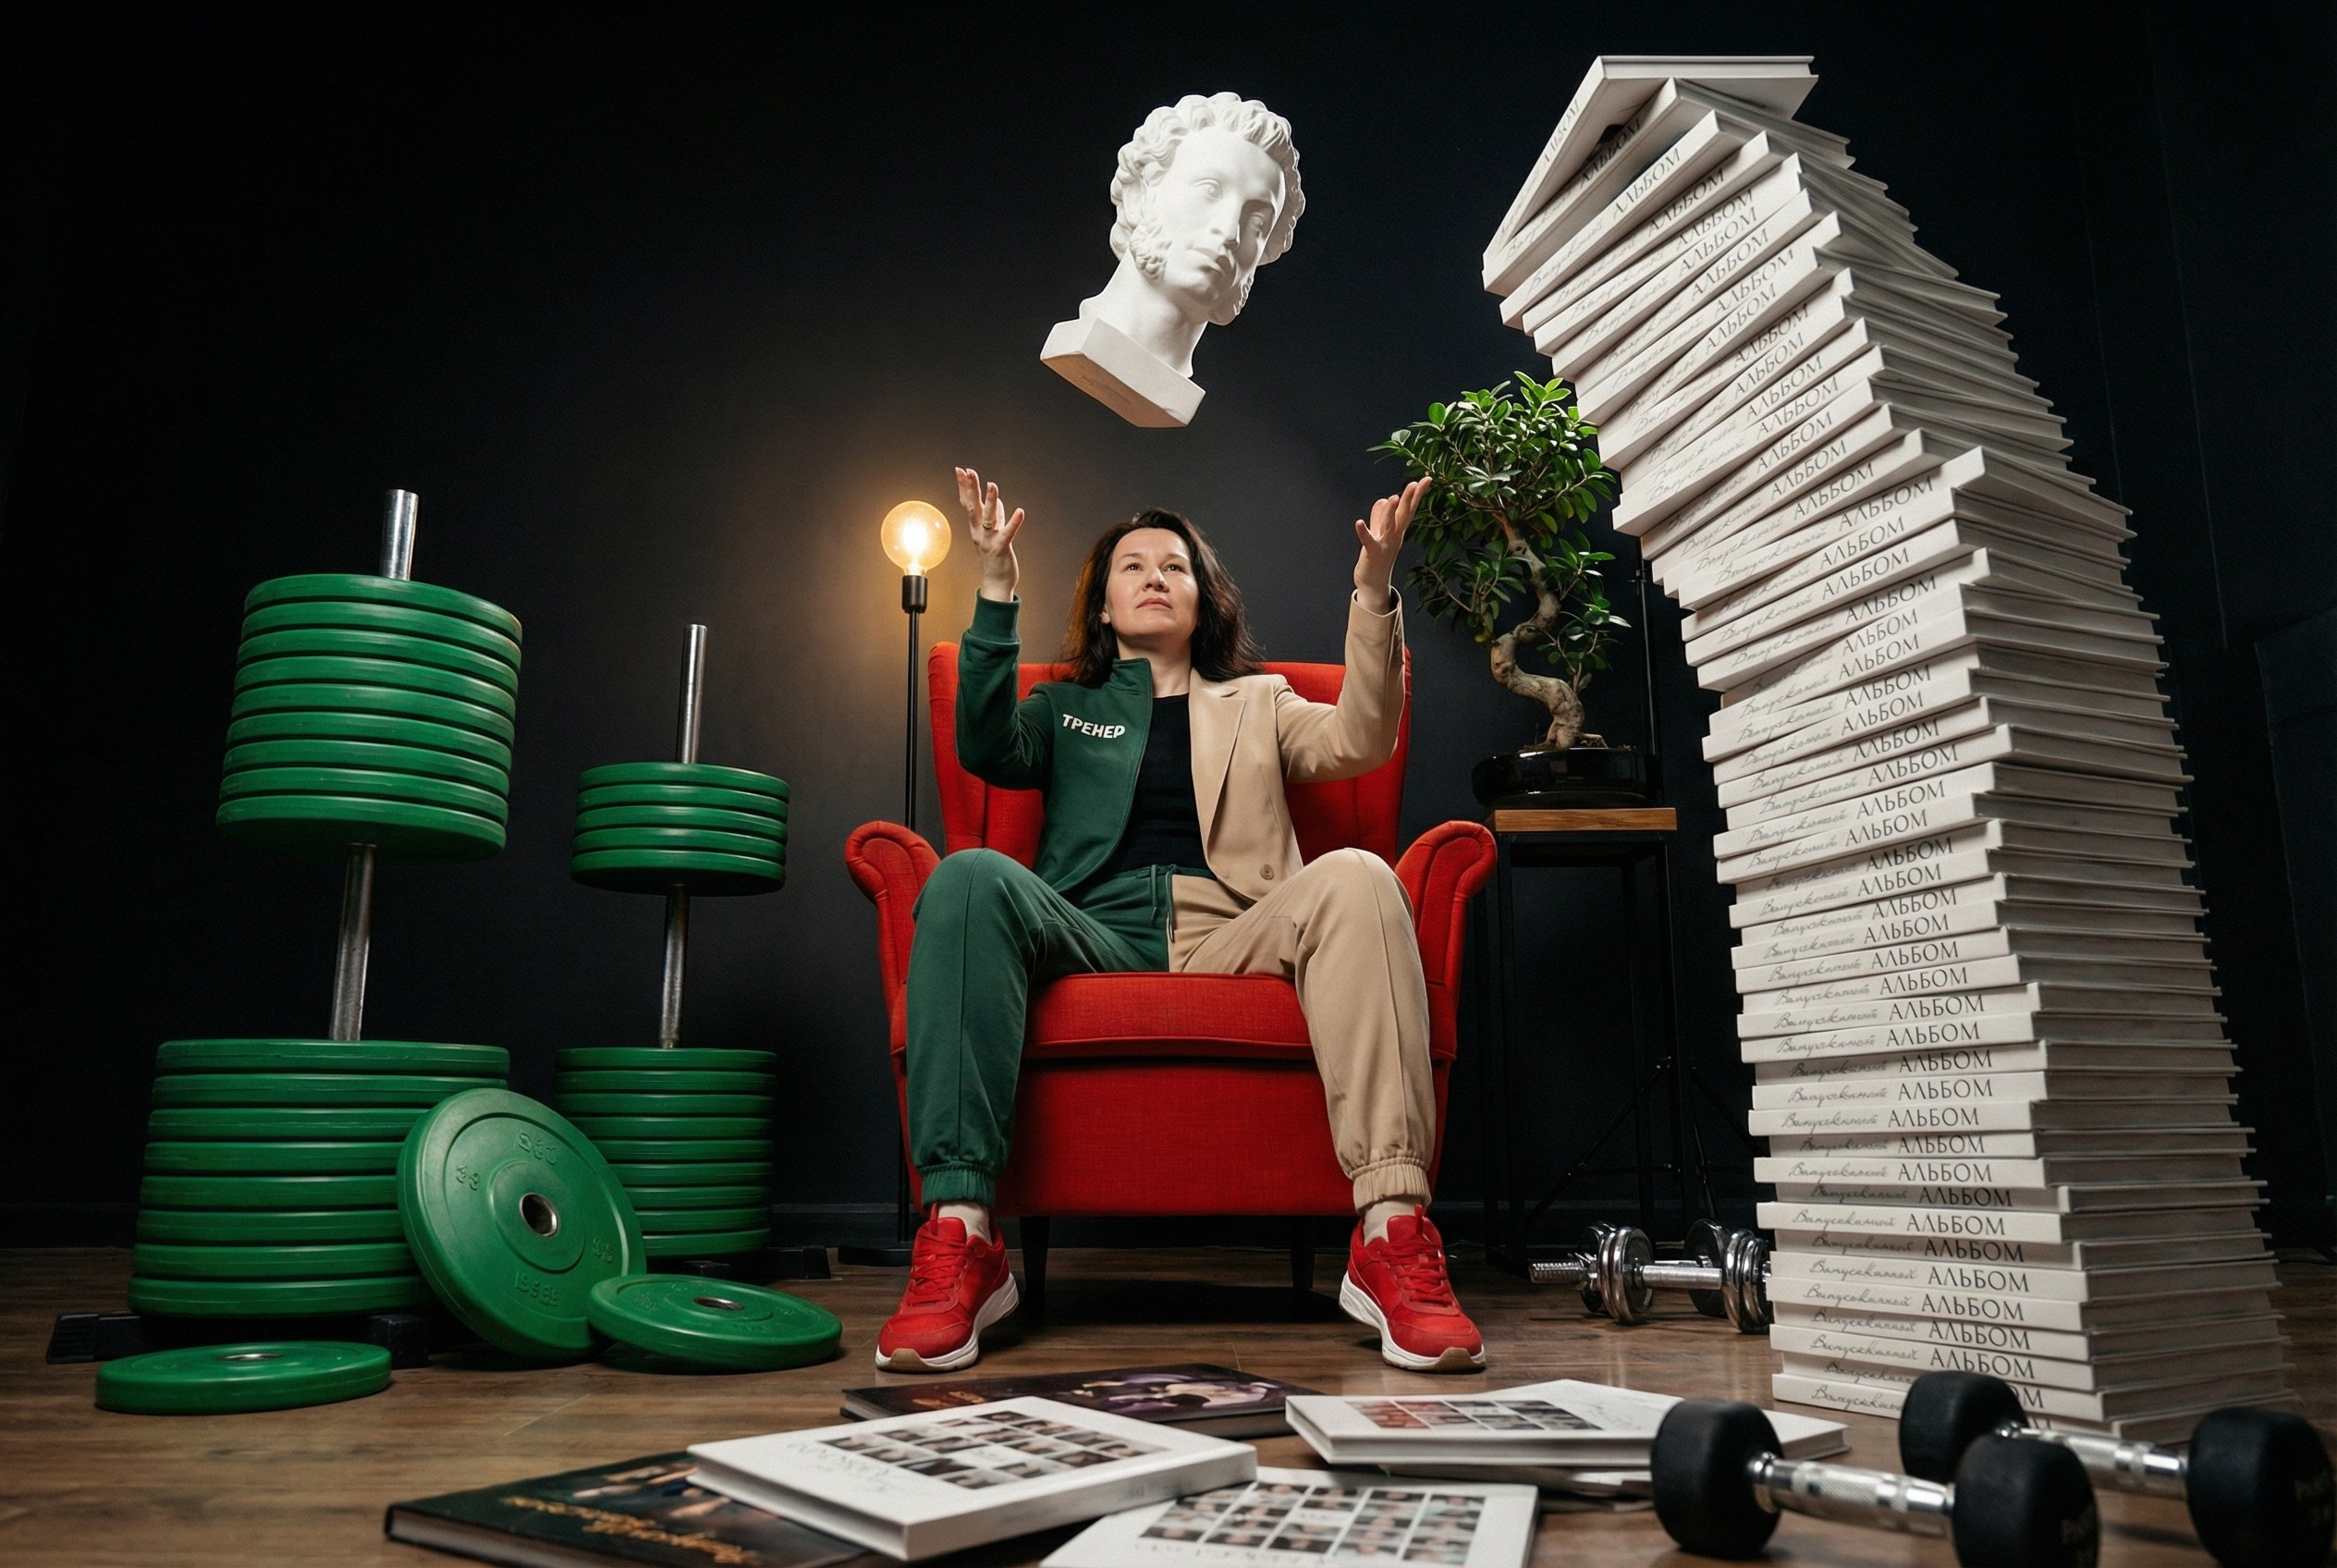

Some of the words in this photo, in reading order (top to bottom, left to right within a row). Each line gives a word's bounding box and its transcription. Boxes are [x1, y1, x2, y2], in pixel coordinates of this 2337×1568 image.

[1613, 147, 1681, 219] АЛЬБОМ
[1648, 168, 1724, 237] АЛЬБОМ
[1677, 189, 1754, 251] АЛЬБОМ
[1680, 206, 1756, 277] АЛЬБОМ
[1692, 228, 1768, 301] АЛЬБОМ
[1715, 249, 1793, 317] АЛЬБОМ
[1707, 282, 1777, 354] АЛЬБОМ
[1733, 302, 1808, 368] АЛЬБОМ
[1734, 332, 1804, 399] АЛЬБОМ
[1746, 354, 1823, 422] АЛЬБОМ
[1756, 375, 1839, 440] АЛЬБОМ
[1756, 410, 1832, 474] АЛЬБОМ
[1770, 439, 1847, 500] АЛЬБОМ
[1793, 461, 1875, 521] АЛЬБОМ
[1839, 475, 1934, 532] АЛЬБОМ
[1819, 515, 1904, 570] АЛЬБОМ
[1822, 547, 1909, 600] АЛЬБОМ
[1844, 574, 1937, 626] АЛЬБОМ
[1842, 607, 1918, 657] АЛЬБОМ
[1839, 632, 1919, 681] АЛЬБОМ
[1843, 664, 1931, 710] АЛЬБОМ
[1062, 714, 1126, 739] ТРЕНЕР
[1841, 691, 1924, 736] АЛЬБОМ
[1853, 717, 1940, 763] АЛЬБОМ
[1867, 743, 1959, 787] АЛЬБОМ
[1855, 779, 1946, 820] АЛЬБОМ
[1845, 809, 1928, 847] АЛЬБОМ
[1866, 836, 1953, 872] АЛЬБОМ
[1857, 863, 1941, 897] АЛЬБОМ
[1871, 888, 1957, 920] АЛЬБОМ
[1864, 913, 1950, 944] АЛЬБОМ
[1870, 940, 1959, 970] АЛЬБОМ
[1879, 966, 1968, 996] АЛЬБОМ
[1889, 994, 1985, 1022] АЛЬБОМ
[1886, 1021, 1980, 1047] АЛЬБОМ
[1898, 1048, 1993, 1073] АЛЬБОМ
[1898, 1078, 1993, 1102] АЛЬБОМ
[1888, 1107, 1980, 1128] АЛЬБОМ
[1897, 1133, 1986, 1155] АЛЬБОМ
[1898, 1162, 1993, 1183] АЛЬБОМ
[1918, 1186, 2013, 1207] АЛЬБОМ
[1906, 1213, 2006, 1236] АЛЬБОМ
[1924, 1237, 2025, 1263] АЛЬБОМ
[1927, 1266, 2030, 1292] АЛЬБОМ
[1921, 1293, 2025, 1321] АЛЬБОМ
[1928, 1319, 2031, 1350] АЛЬБОМ
[1930, 1347, 2036, 1379] АЛЬБОМ
